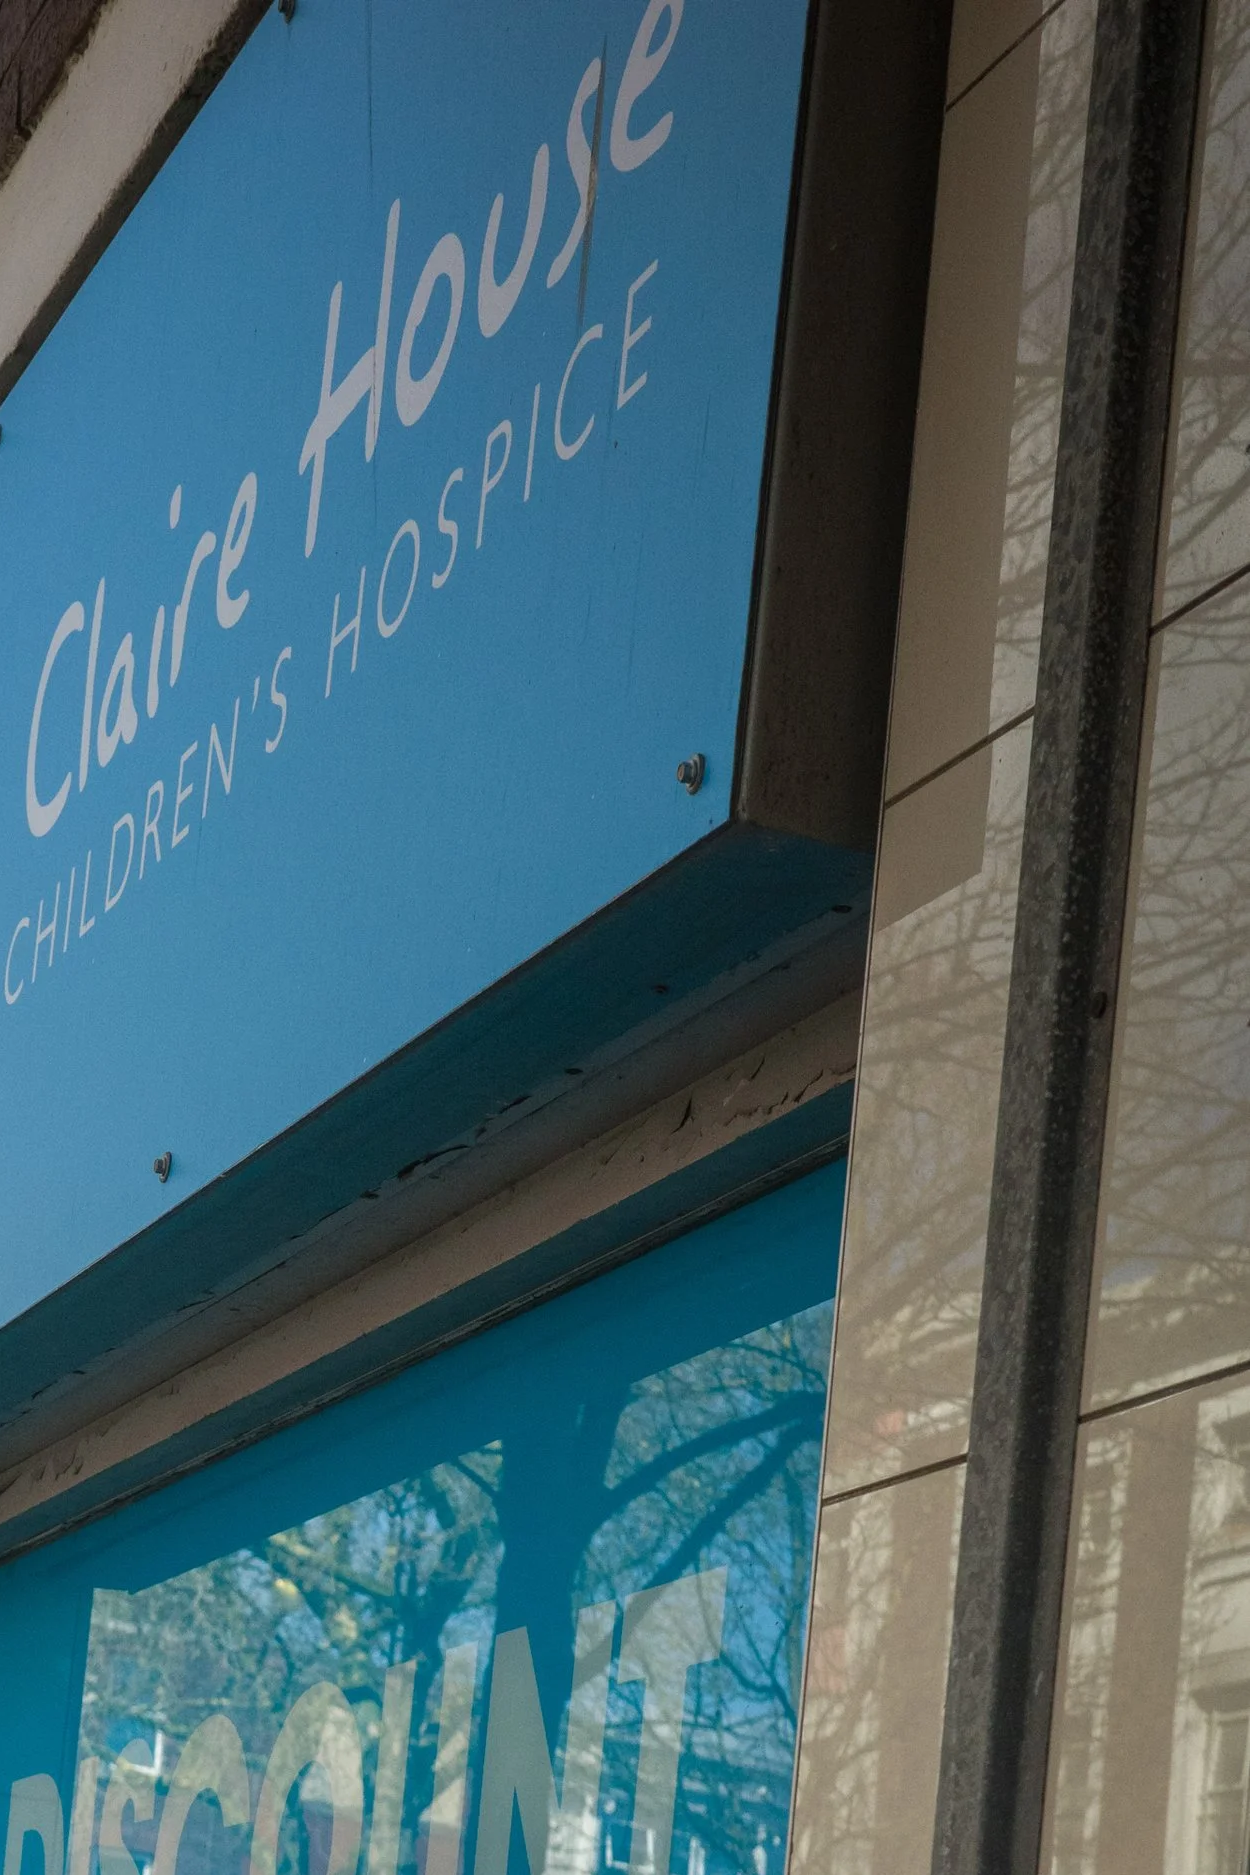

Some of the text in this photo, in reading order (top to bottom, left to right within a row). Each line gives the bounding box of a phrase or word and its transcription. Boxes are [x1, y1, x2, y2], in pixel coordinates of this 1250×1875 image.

[3, 258, 660, 1005] CHILDREN'S HOSPICE
[25, 0, 687, 838] Claire House
